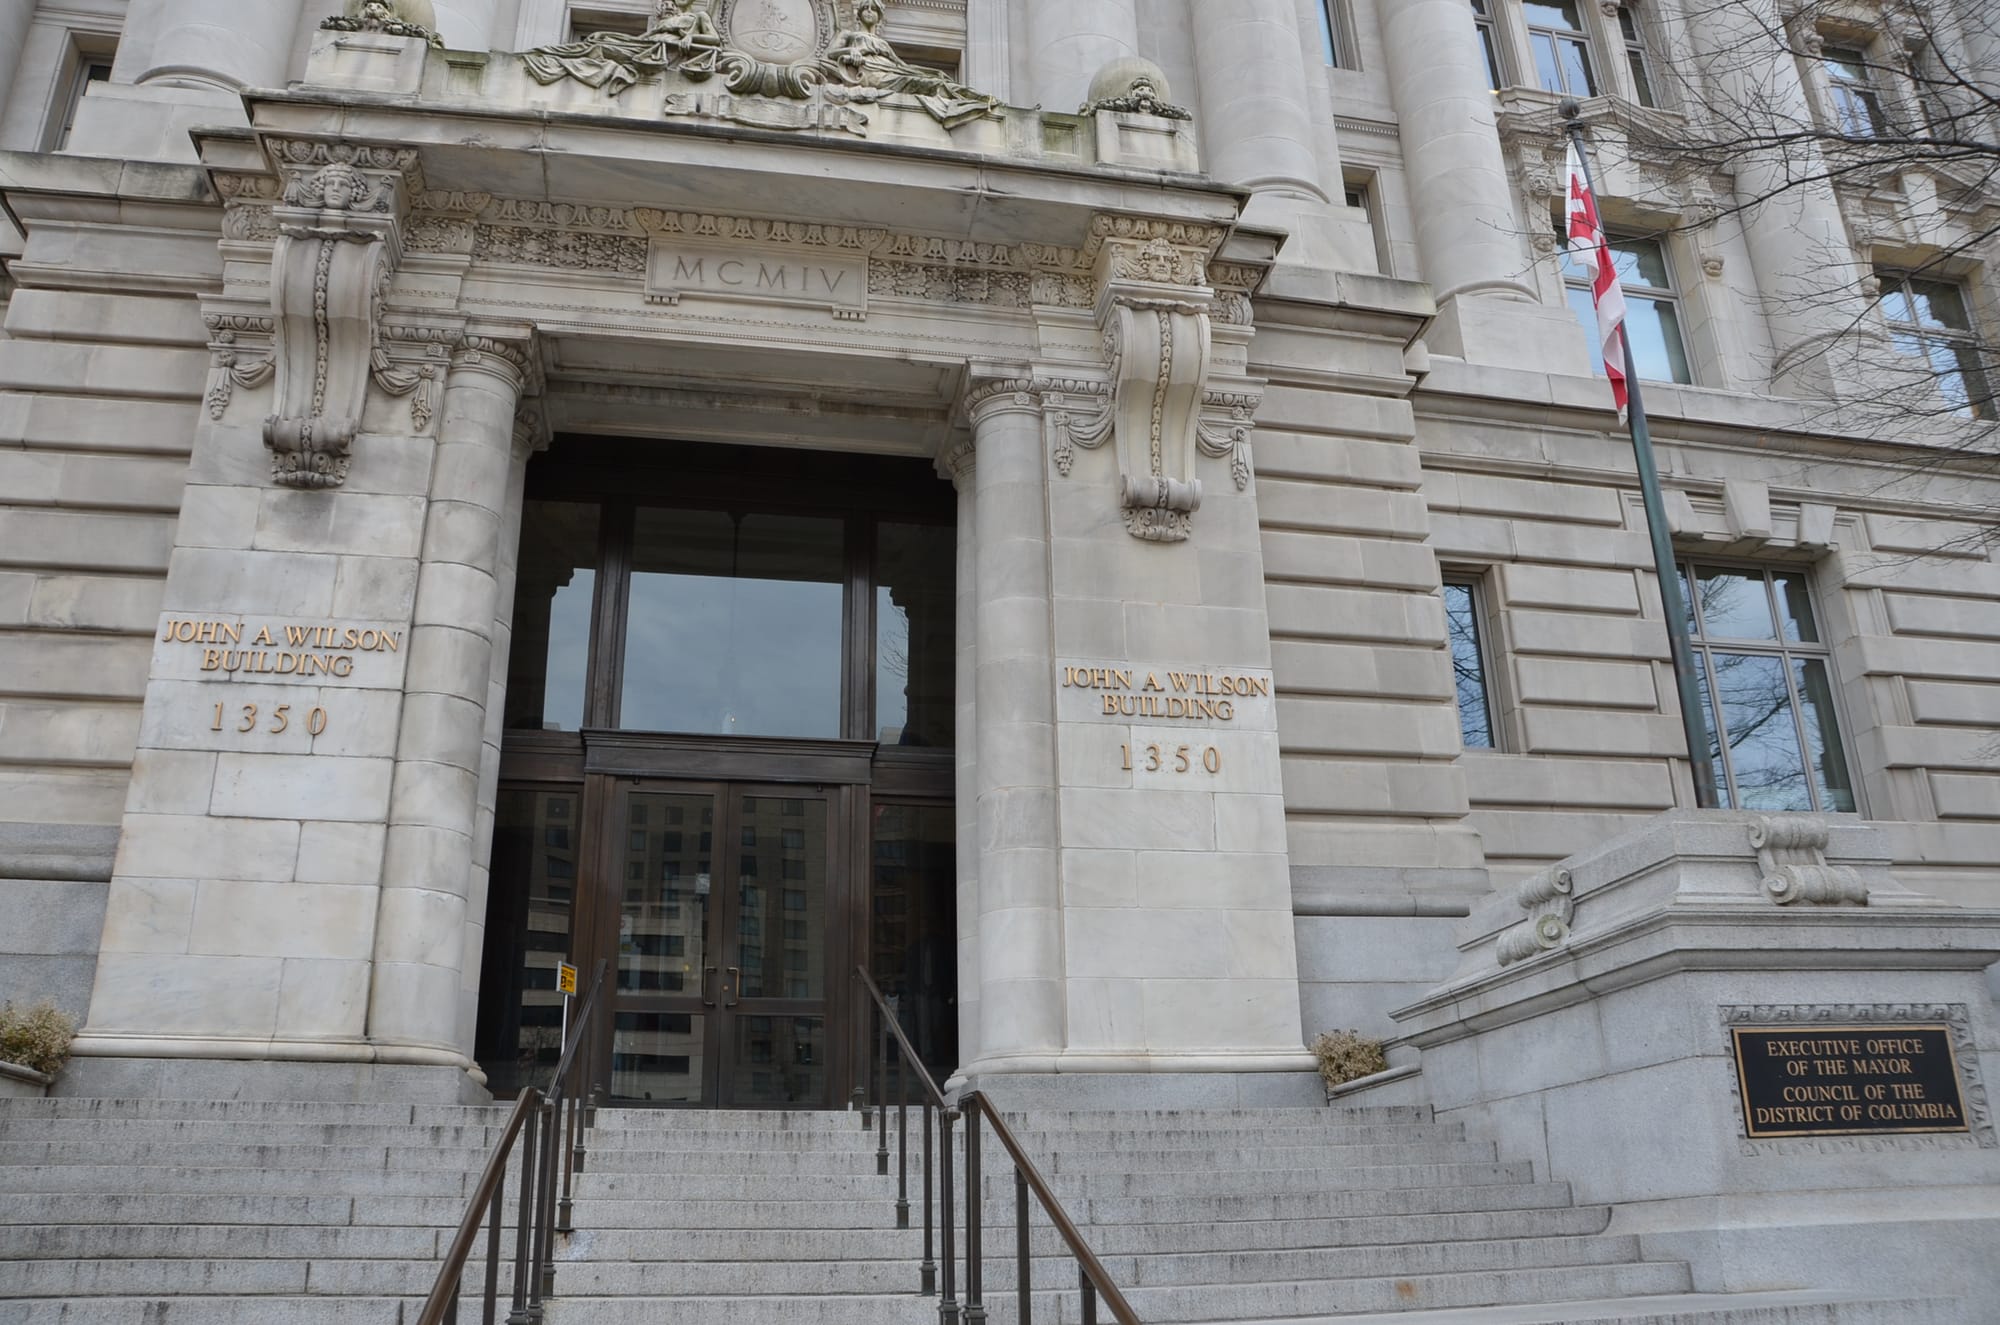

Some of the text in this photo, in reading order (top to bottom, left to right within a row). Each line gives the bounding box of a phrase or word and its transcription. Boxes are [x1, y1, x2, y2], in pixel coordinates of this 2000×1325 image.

[672, 255, 846, 294] MCMIV
[162, 620, 244, 644] JOHN
[284, 624, 401, 652] WILSON
[200, 649, 354, 677] BUILDING
[1063, 666, 1132, 690] JOHN
[1168, 672, 1269, 697] WILSON
[210, 701, 328, 735] 1350
[1101, 694, 1235, 721] BUILDING
[1120, 744, 1222, 773] 1350
[1767, 1039, 1925, 1057] EXECUTIVE OFFICE
[1786, 1058, 1913, 1076] OF THE MAYOR
[1783, 1083, 1925, 1103] COUNCIL OF THE
[1756, 1103, 1958, 1124] DISTRICT OF COLUMBIA
